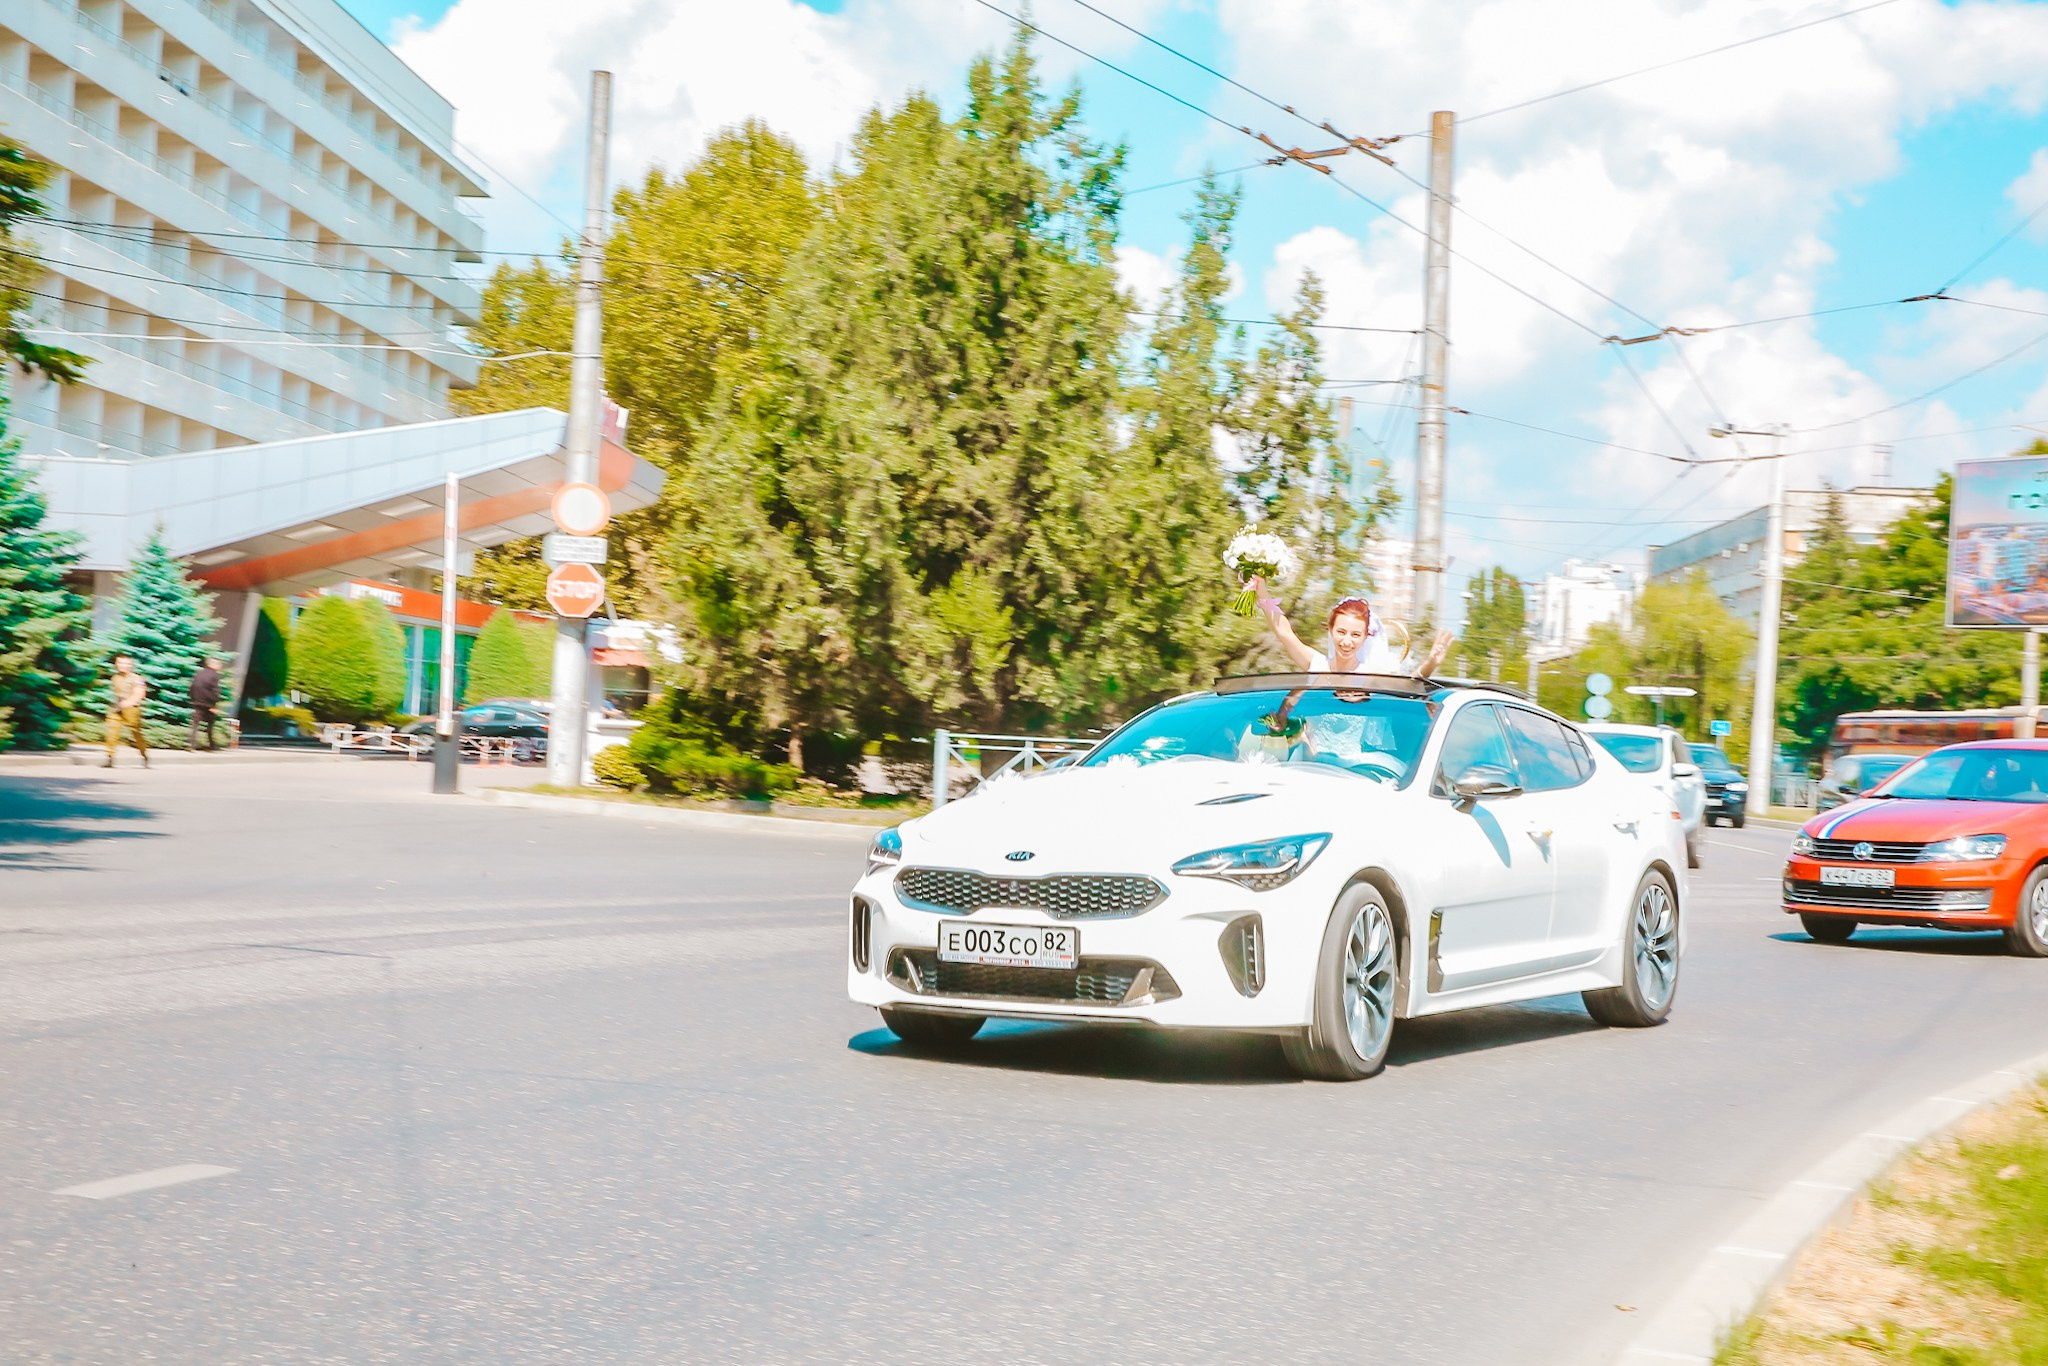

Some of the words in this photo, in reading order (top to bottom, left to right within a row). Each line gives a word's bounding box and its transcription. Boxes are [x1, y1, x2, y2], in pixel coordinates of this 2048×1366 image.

[551, 580, 600, 599] STOP
[1007, 851, 1032, 860] KIA
[1044, 932, 1066, 951] 82
[1043, 951, 1059, 959] RUS
